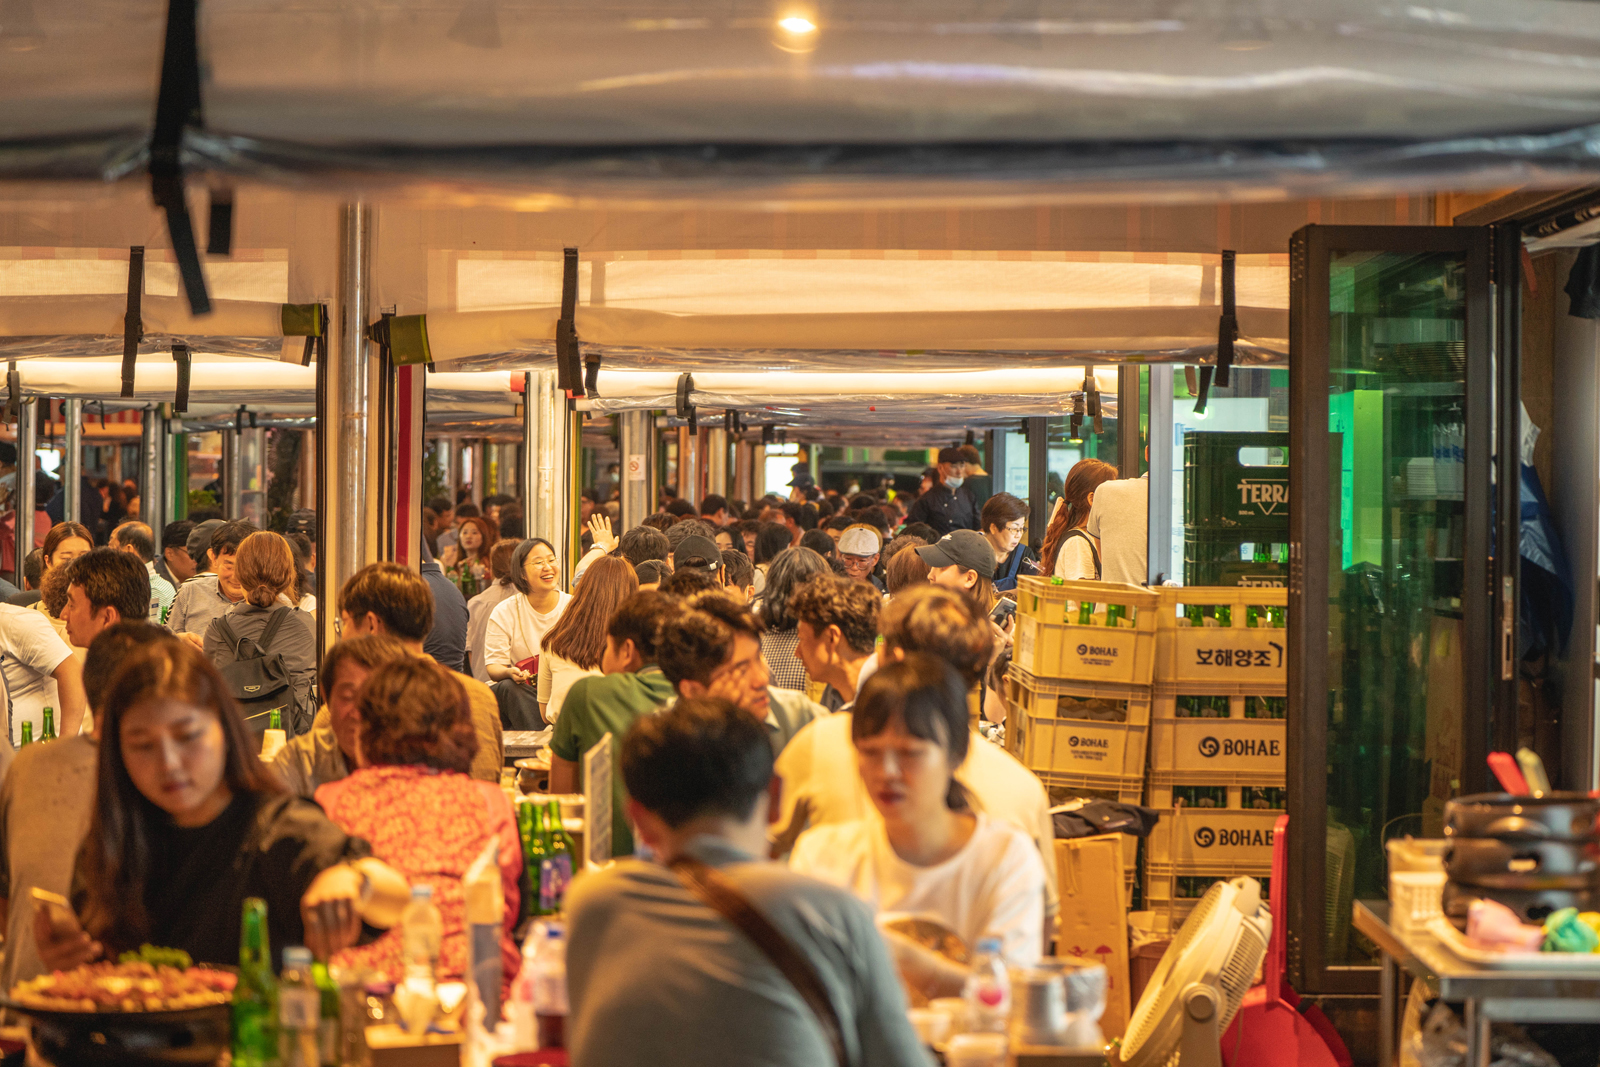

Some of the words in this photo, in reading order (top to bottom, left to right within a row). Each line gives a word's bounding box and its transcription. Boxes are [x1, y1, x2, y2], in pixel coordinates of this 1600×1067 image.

[1089, 645, 1119, 657] BOHAE
[1196, 648, 1271, 667] 보해양조
[1080, 737, 1109, 748] BOHAE
[1223, 738, 1280, 756] BOHAE
[1219, 829, 1274, 846] BOHAE
